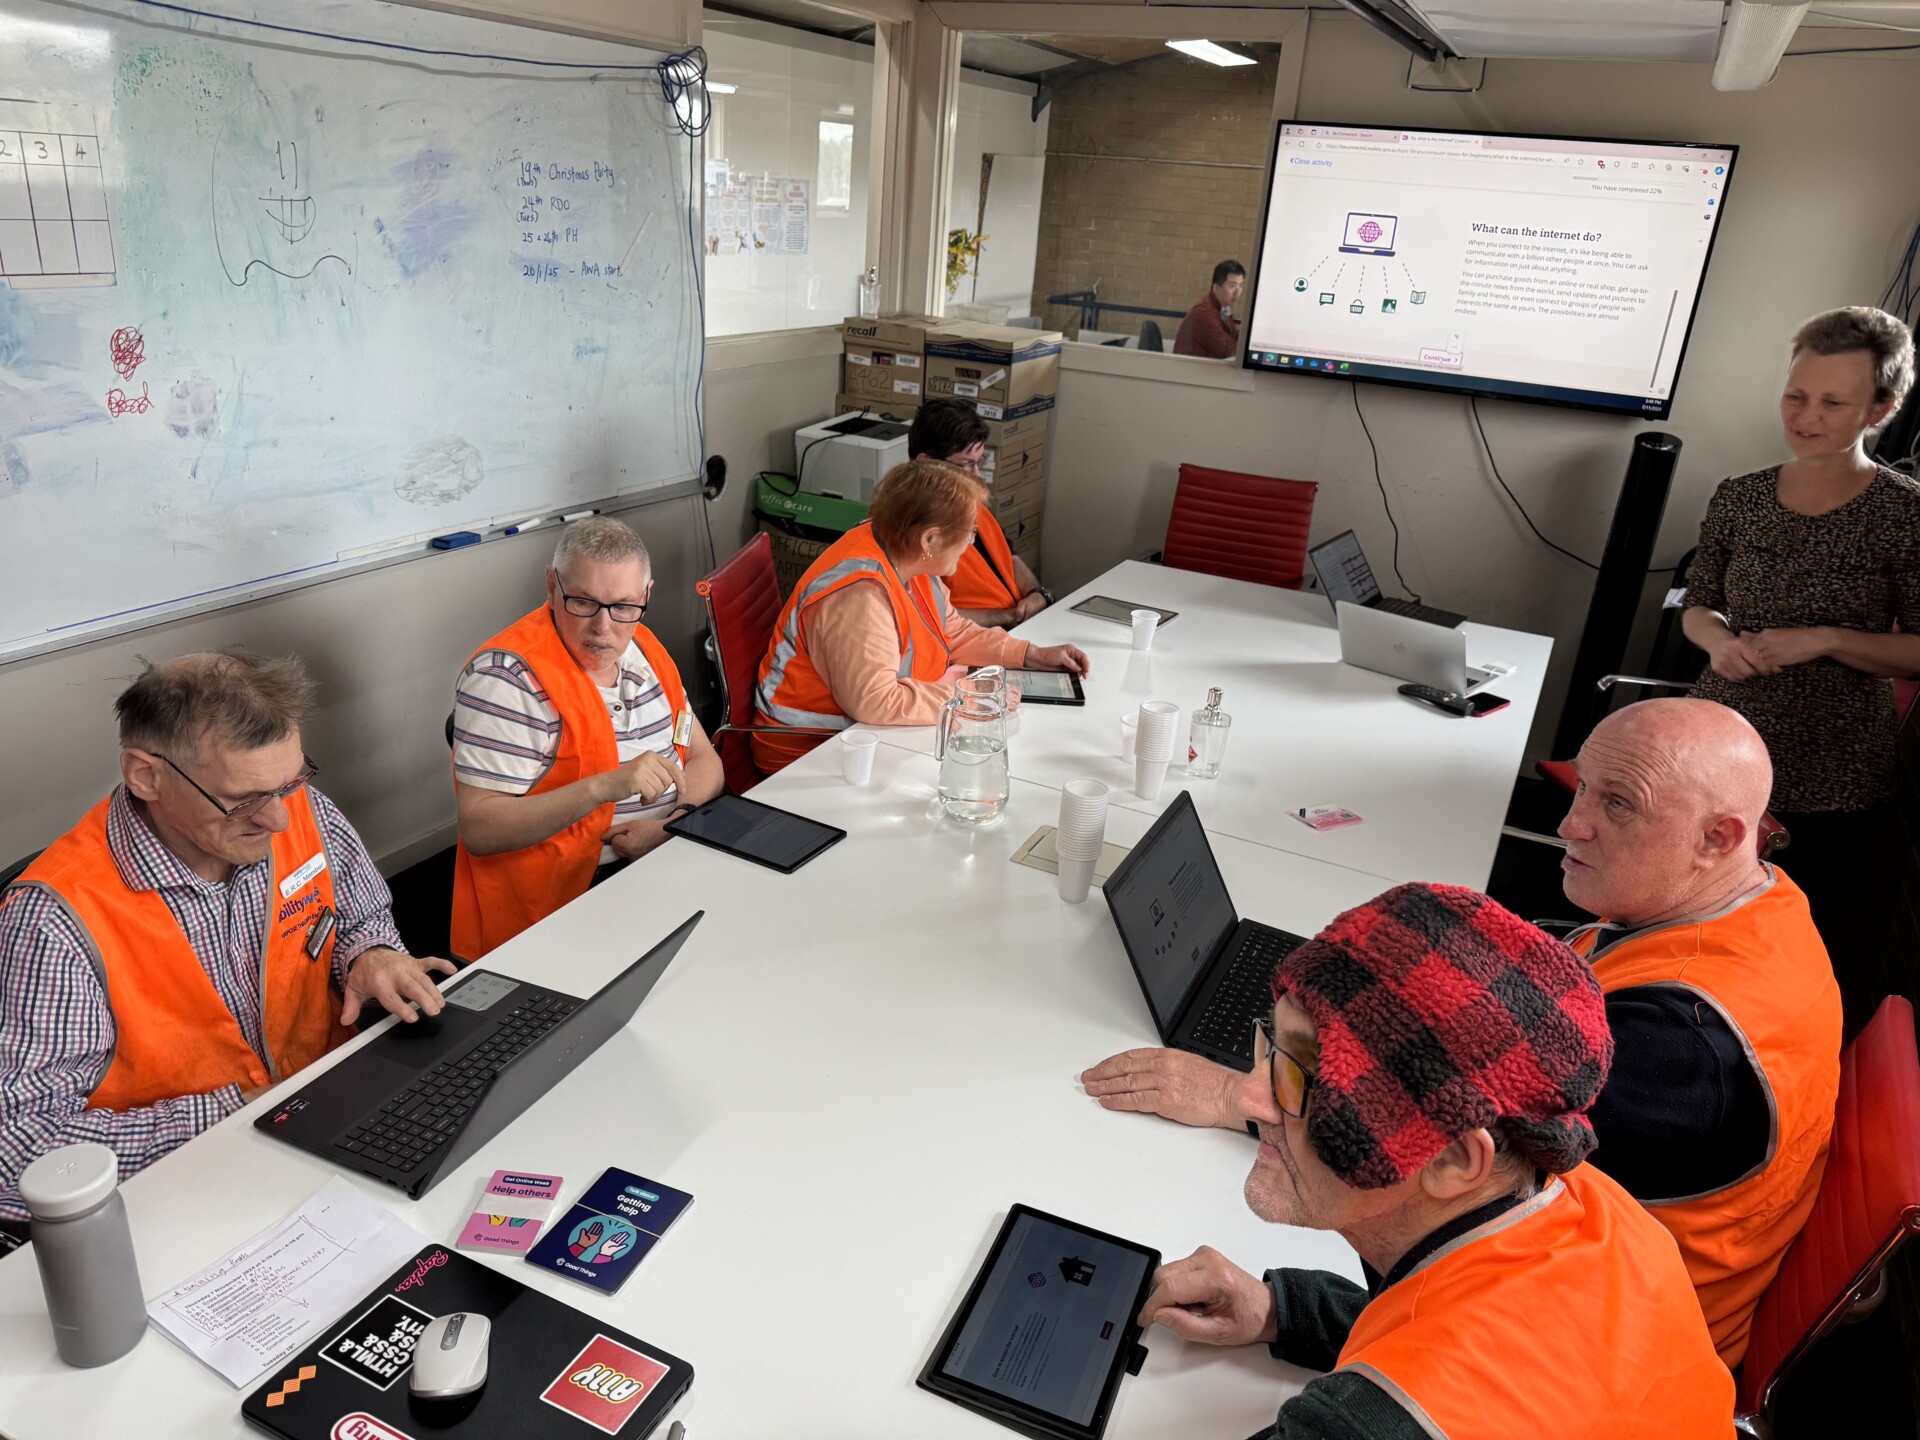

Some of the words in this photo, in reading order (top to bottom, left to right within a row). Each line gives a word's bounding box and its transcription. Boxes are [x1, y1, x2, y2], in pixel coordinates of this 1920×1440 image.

[34, 141, 48, 160] 3
[75, 142, 87, 160] 4
[1293, 156, 1310, 166] Close
[1311, 158, 1333, 169] activity
[594, 160, 615, 188] Party
[1592, 183, 1602, 192] You
[1603, 185, 1617, 193] have
[1618, 186, 1648, 197] completed
[550, 196, 570, 211] RDO
[522, 232, 534, 243] 25
[566, 227, 578, 243] PH
[1472, 223, 1498, 234] What
[1500, 227, 1519, 235] can
[1521, 227, 1538, 236] the
[1539, 228, 1581, 240] internet
[1582, 232, 1602, 242] do?
[1466, 249, 1506, 258] communicate
[1507, 252, 1520, 260] with
[1563, 257, 1585, 266] people
[1498, 242, 1522, 250] connect
[1591, 250, 1610, 259] being
[523, 263, 559, 285] 20/1/25
[1474, 259, 1509, 268] information
[1518, 262, 1531, 271] just
[1530, 264, 1549, 272] about
[1485, 273, 1514, 282] purchase
[1514, 276, 1532, 284] goods
[1533, 277, 1549, 285] from
[1586, 282, 1600, 290] real
[1617, 286, 1629, 294] get
[1458, 289, 1475, 298] family
[1520, 295, 1535, 303] even
[1536, 297, 1561, 305] connect
[1568, 301, 1590, 309] groups
[1598, 304, 1621, 313] people
[1493, 283, 1509, 291] news
[1509, 284, 1525, 292] from
[1556, 289, 1572, 297] send
[1572, 291, 1598, 300] updates
[1598, 293, 1612, 301] and
[1612, 295, 1637, 304] pictures
[1456, 299, 1482, 307] interests
[1493, 302, 1510, 310] same
[1538, 306, 1550, 314] The
[1550, 308, 1586, 318] possibilities
[1597, 312, 1620, 321] almost
[846, 325, 877, 341] recall
[504, 1175, 515, 1184] Get
[515, 1177, 534, 1186] Online
[535, 1179, 551, 1188] Week
[492, 1184, 517, 1197] Help
[518, 1187, 551, 1199] others
[639, 1189, 656, 1200] about
[616, 1193, 653, 1213] Getting
[617, 1202, 640, 1217] help
[483, 1235, 501, 1244] Good
[500, 1236, 520, 1247] Things
[395, 1250, 449, 1292] Rapha
[565, 1261, 580, 1272] Good
[579, 1264, 598, 1279] Things
[363, 1333, 411, 1365] CSS&
[262, 1350, 287, 1369] Tuesday
[338, 1338, 399, 1379] HTML&
